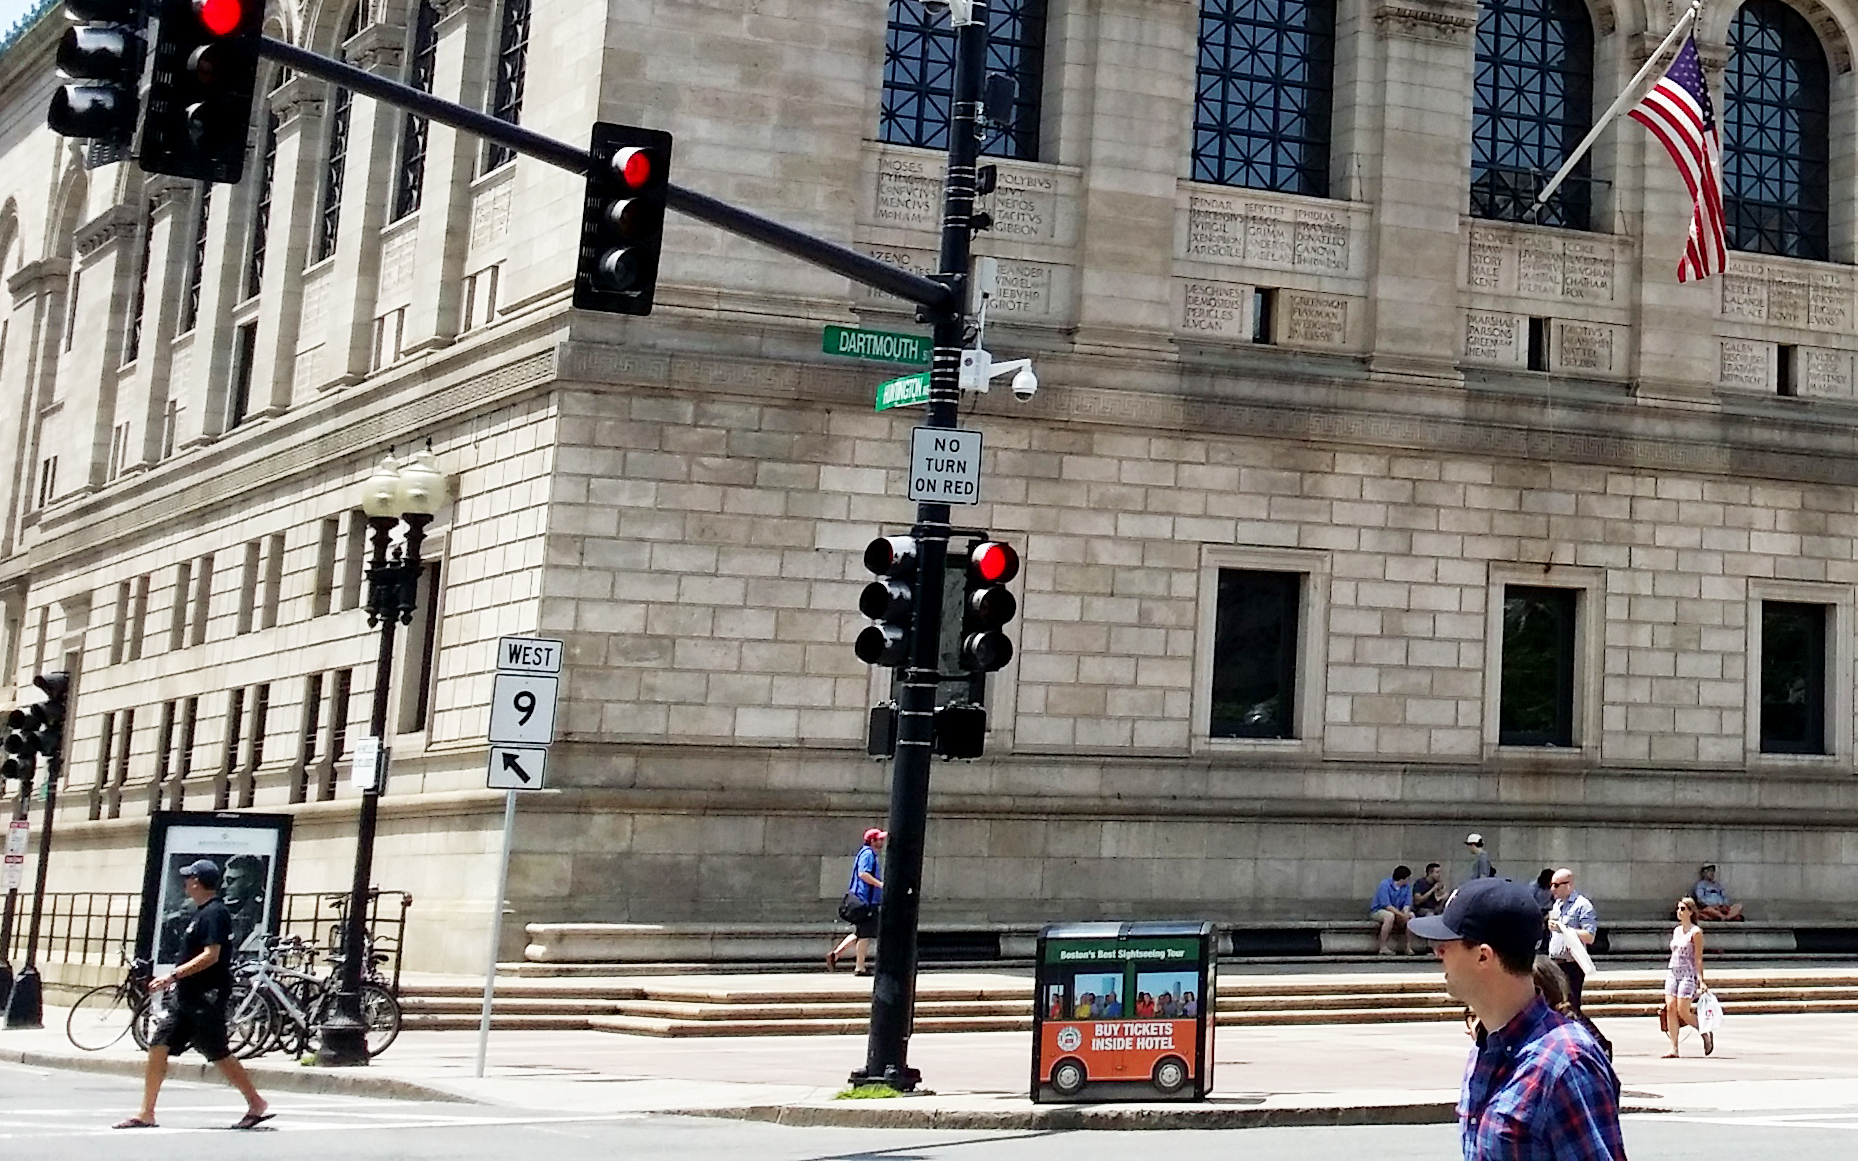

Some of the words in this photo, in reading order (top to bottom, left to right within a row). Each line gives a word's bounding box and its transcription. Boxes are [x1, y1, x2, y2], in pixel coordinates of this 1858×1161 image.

[998, 264, 1044, 278] EANDER
[999, 289, 1040, 301] IEBVHR
[839, 331, 919, 360] DARTMOUTH
[883, 377, 924, 405] HUNTINGTON
[934, 438, 960, 453] NO
[925, 458, 967, 474] TURN
[915, 478, 937, 493] ON
[943, 480, 974, 496] RED
[509, 644, 553, 666] WEST
[513, 691, 536, 726] 9
[1060, 950, 1096, 960] Boston's
[1097, 950, 1116, 959] Best
[1118, 949, 1165, 960] Sightseeing
[1167, 949, 1185, 958] Tour
[1094, 1023, 1120, 1037] BUY
[1123, 1022, 1173, 1036] TICKETS
[1091, 1038, 1133, 1051] INSIDE
[1136, 1037, 1175, 1050] HOTEL
